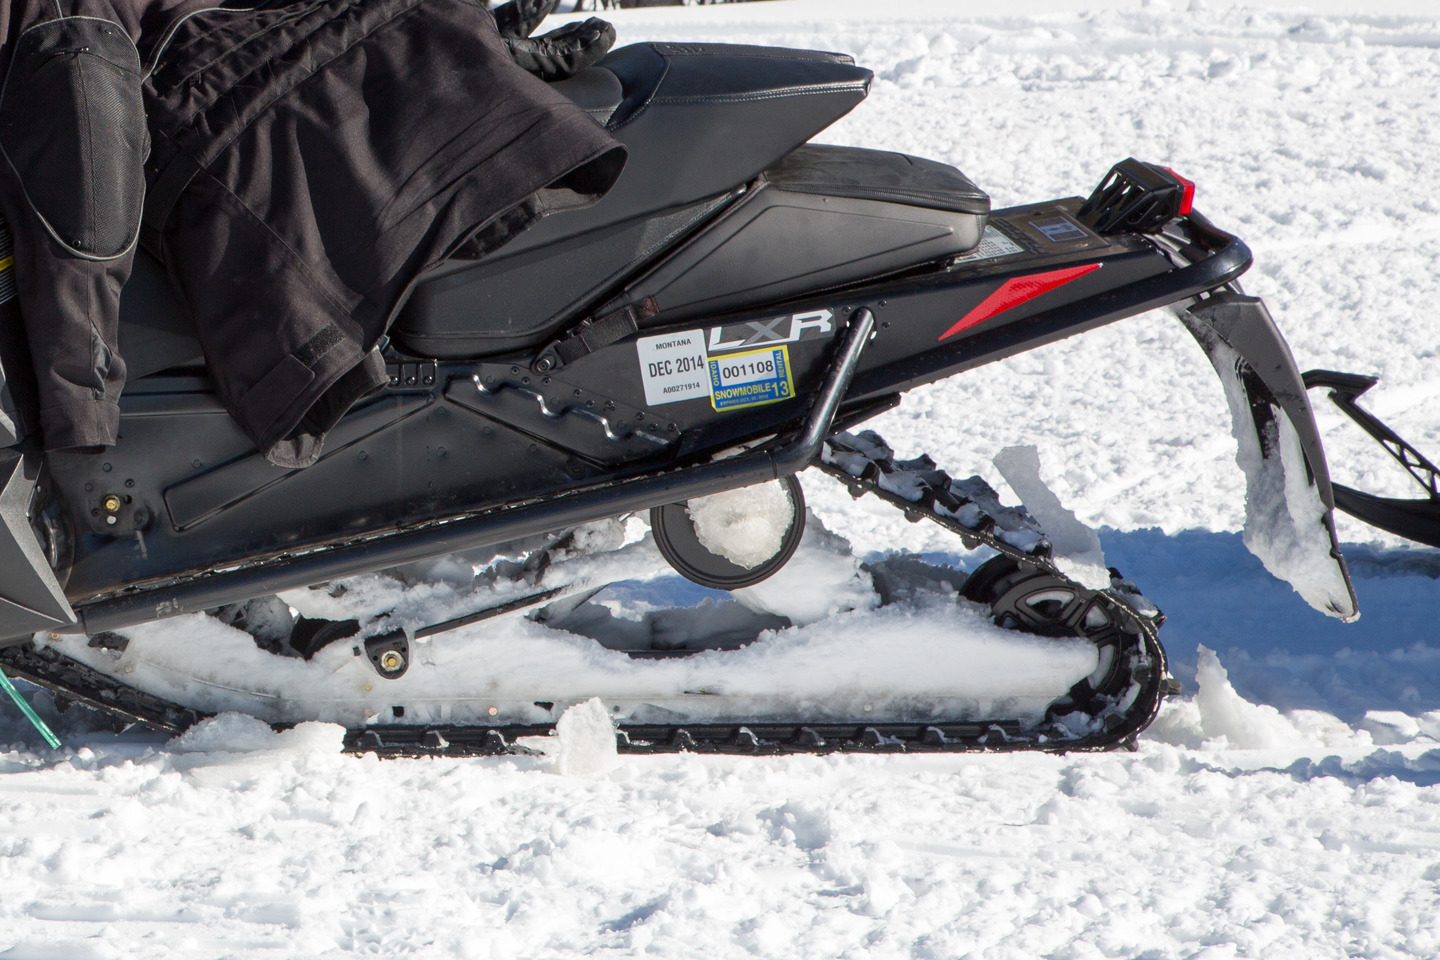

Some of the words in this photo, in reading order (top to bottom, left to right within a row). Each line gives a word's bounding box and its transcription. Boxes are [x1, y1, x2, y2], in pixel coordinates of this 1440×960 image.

[708, 309, 833, 351] LXR
[655, 338, 691, 350] MONTANA
[648, 360, 672, 377] DEC
[675, 355, 704, 373] 2014
[709, 361, 719, 386] IDAHO
[722, 360, 774, 379] 001108
[775, 351, 785, 378] RENTAL
[714, 382, 771, 400] SNOWMOBILE
[771, 380, 789, 396] 13
